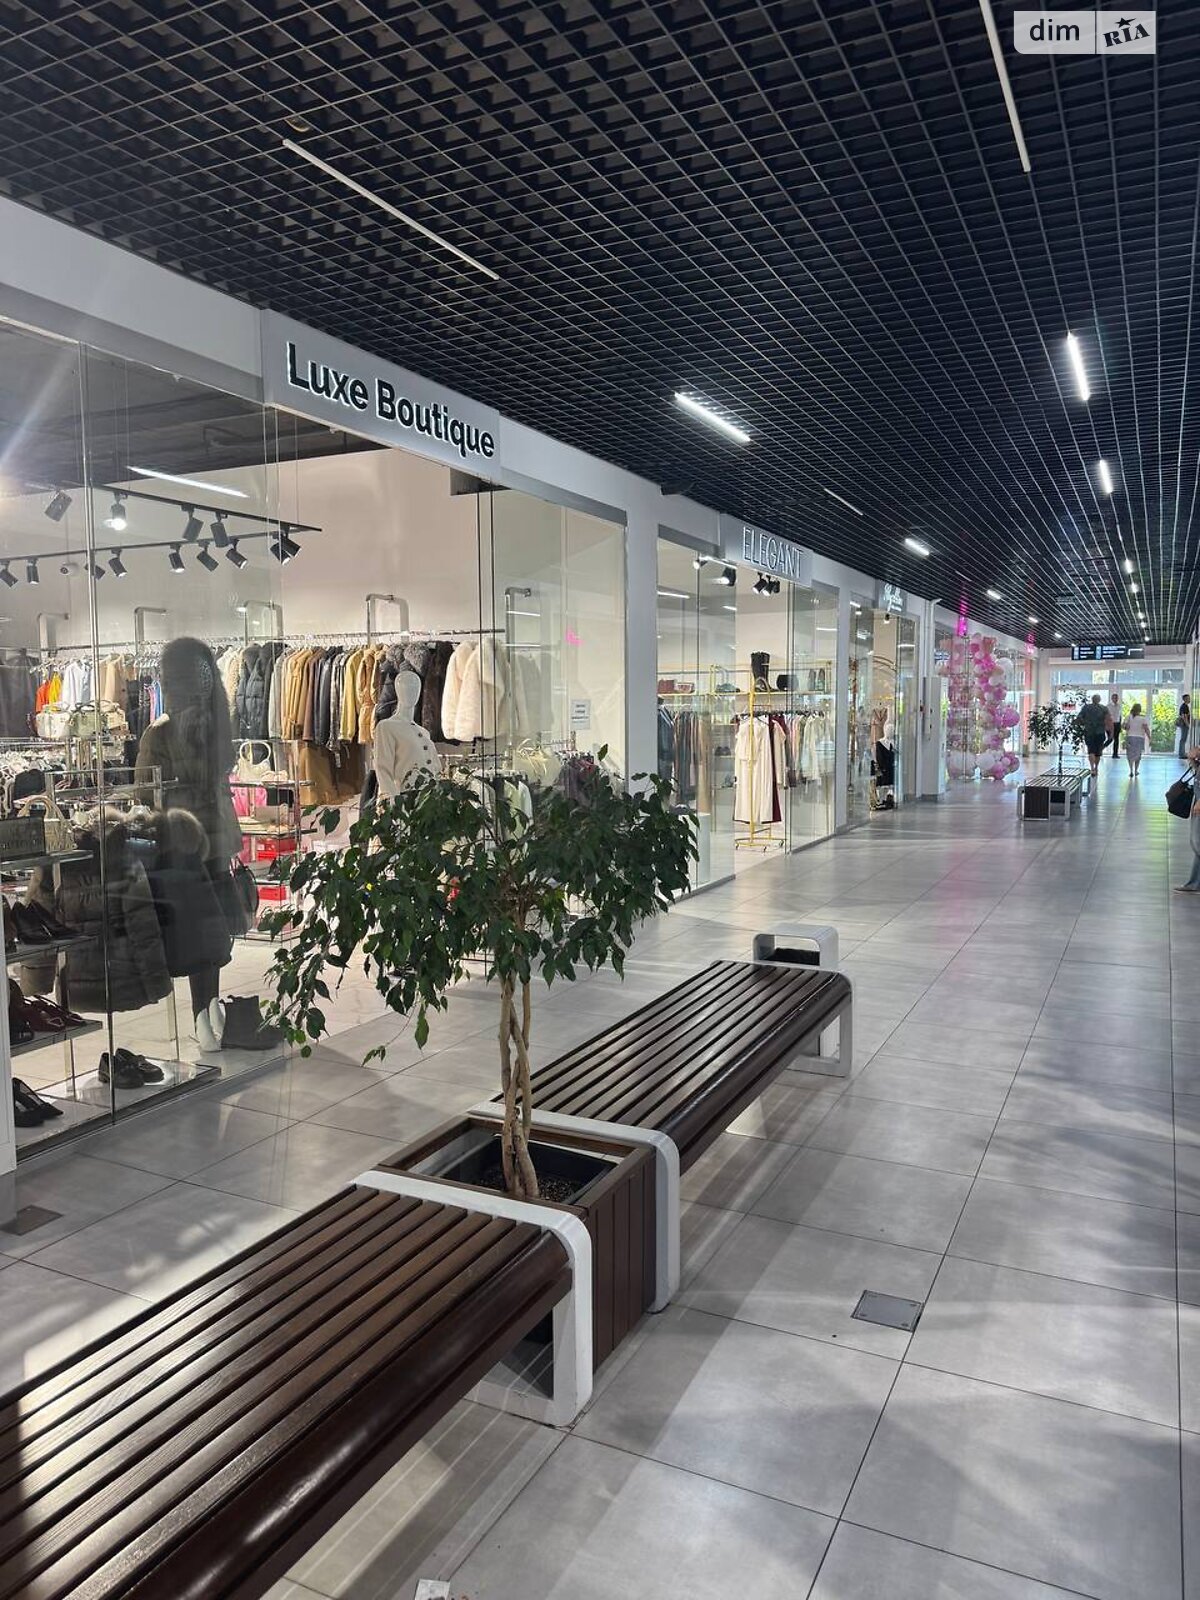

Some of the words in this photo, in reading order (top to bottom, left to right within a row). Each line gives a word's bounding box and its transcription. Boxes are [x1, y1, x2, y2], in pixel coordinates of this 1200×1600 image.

[286, 341, 369, 411] Luxe
[375, 378, 495, 459] Boutique
[743, 526, 804, 579] ELEGANT
